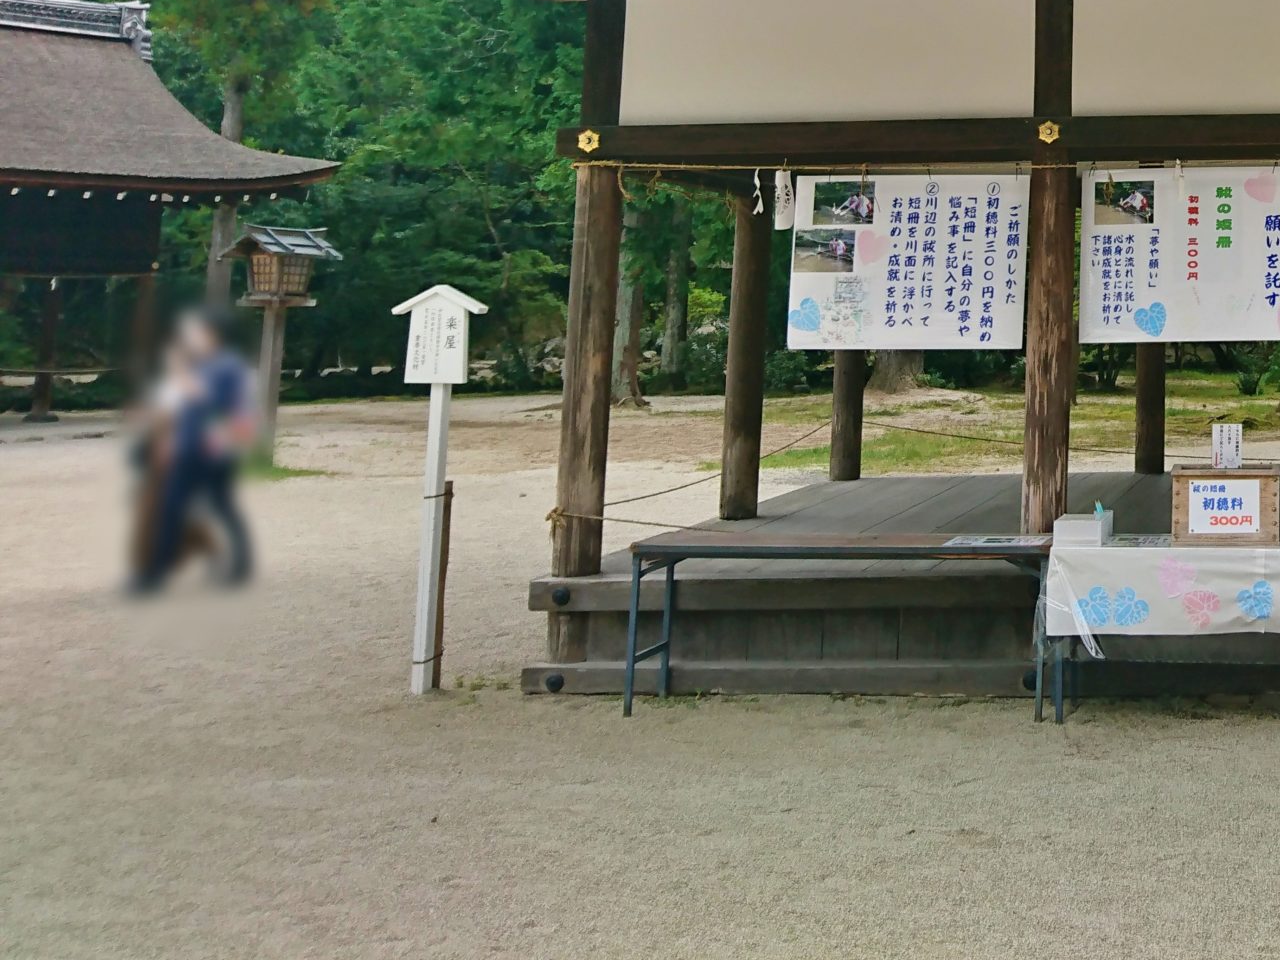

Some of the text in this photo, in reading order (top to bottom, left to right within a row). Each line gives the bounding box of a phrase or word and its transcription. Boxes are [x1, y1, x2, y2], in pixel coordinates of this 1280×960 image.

[884, 196, 903, 328] お清め・成就を祈る
[901, 197, 921, 327] 短冊を川面に浮かべ
[944, 195, 962, 313] 悩み事を記入する
[958, 196, 978, 337] 「短冊」に自分の夢や
[979, 182, 1000, 342] ①初穂料三〇〇円を納め
[1004, 204, 1021, 304] ご祈願のしかた
[1091, 235, 1102, 267] 下さい
[1101, 234, 1113, 326] 諸願成就をお祈り
[1113, 234, 1124, 325] 心身ともに清めて
[1124, 234, 1135, 313] 水の流れに託し
[1148, 229, 1160, 288] 「夢や願い」
[1202, 496, 1244, 511] 初穂料
[1209, 515, 1253, 526] 300円
